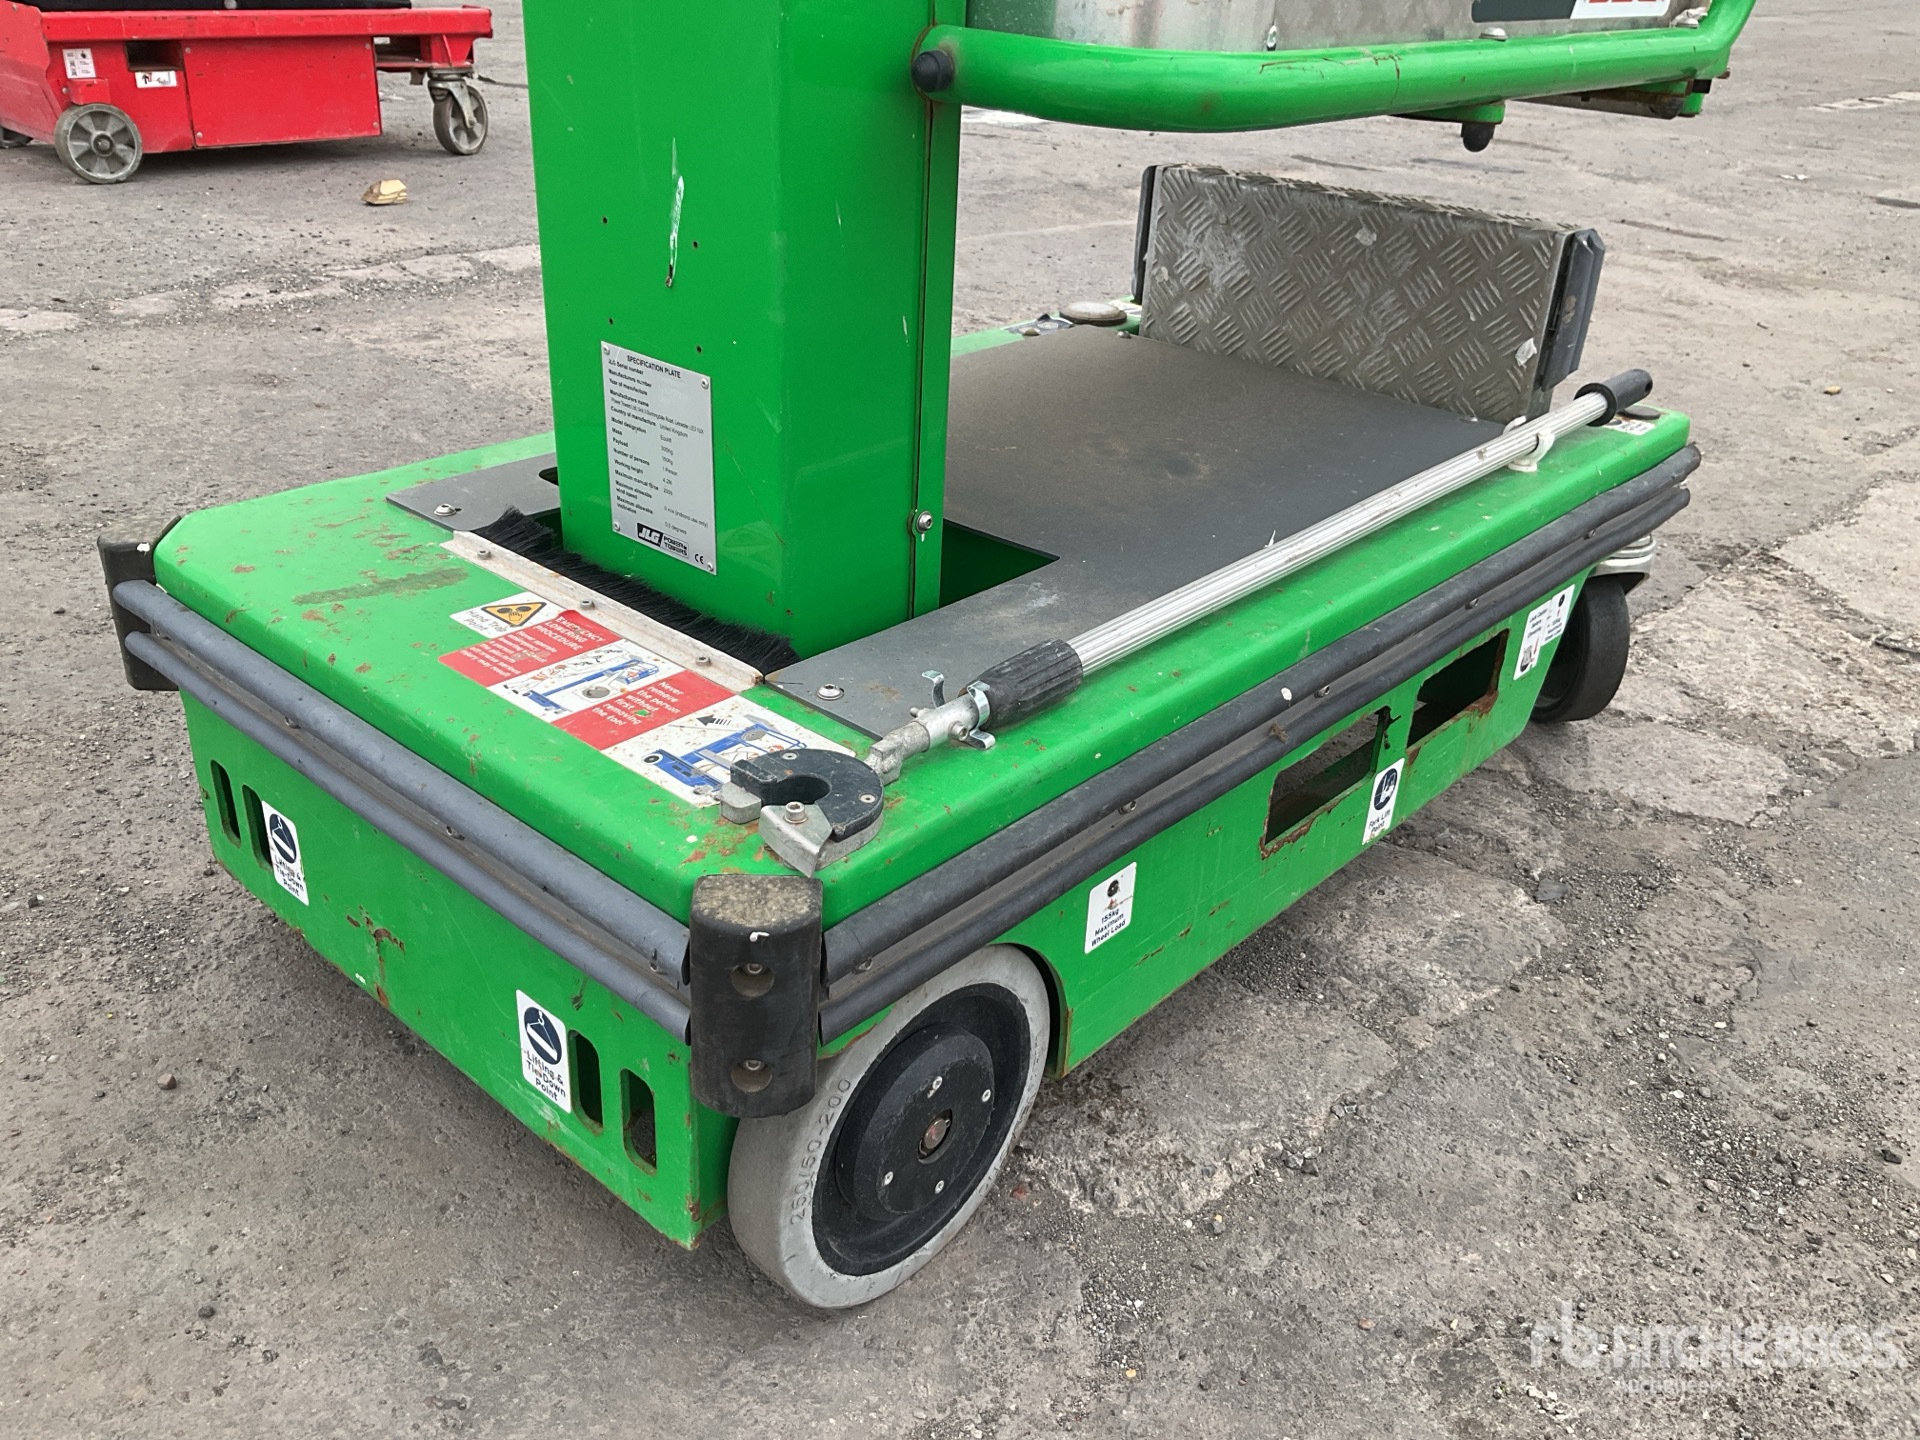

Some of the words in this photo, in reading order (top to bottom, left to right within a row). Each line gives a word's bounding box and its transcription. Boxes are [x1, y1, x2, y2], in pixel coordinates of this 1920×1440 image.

[627, 355, 663, 373] SPECIFICATION
[665, 367, 681, 378] PLATE
[629, 366, 643, 374] number
[611, 406, 626, 416] Country
[632, 414, 656, 426] manufacture
[612, 417, 623, 425] Model
[660, 424, 671, 432] United
[672, 429, 688, 439] Kingdom
[613, 438, 628, 448] Payload
[613, 448, 628, 457] Number
[634, 456, 650, 466] persons
[614, 459, 630, 470] Working
[631, 466, 643, 475] height
[615, 470, 633, 480] Maximum
[634, 477, 648, 486] manual
[638, 526, 661, 545] JLG
[664, 536, 683, 549] POWER
[664, 542, 687, 556] TOWERS
[533, 625, 583, 650] PROCEDURE
[546, 621, 587, 642] LOWERING
[648, 686, 679, 703] remove
[659, 681, 685, 695] Never
[615, 698, 635, 709] first
[626, 694, 659, 712] without
[637, 690, 654, 699] the
[651, 698, 681, 714] person
[593, 707, 609, 716] the
[607, 715, 627, 726] tool
[603, 703, 644, 725] removing
[283, 879, 299, 896] Point
[1095, 913, 1124, 936] Maximum
[1102, 909, 1119, 924] 155kg
[1091, 931, 1110, 946] Wheel
[1111, 919, 1125, 934] Load
[527, 1050, 555, 1080] Lifting
[536, 1078, 558, 1101] Point
